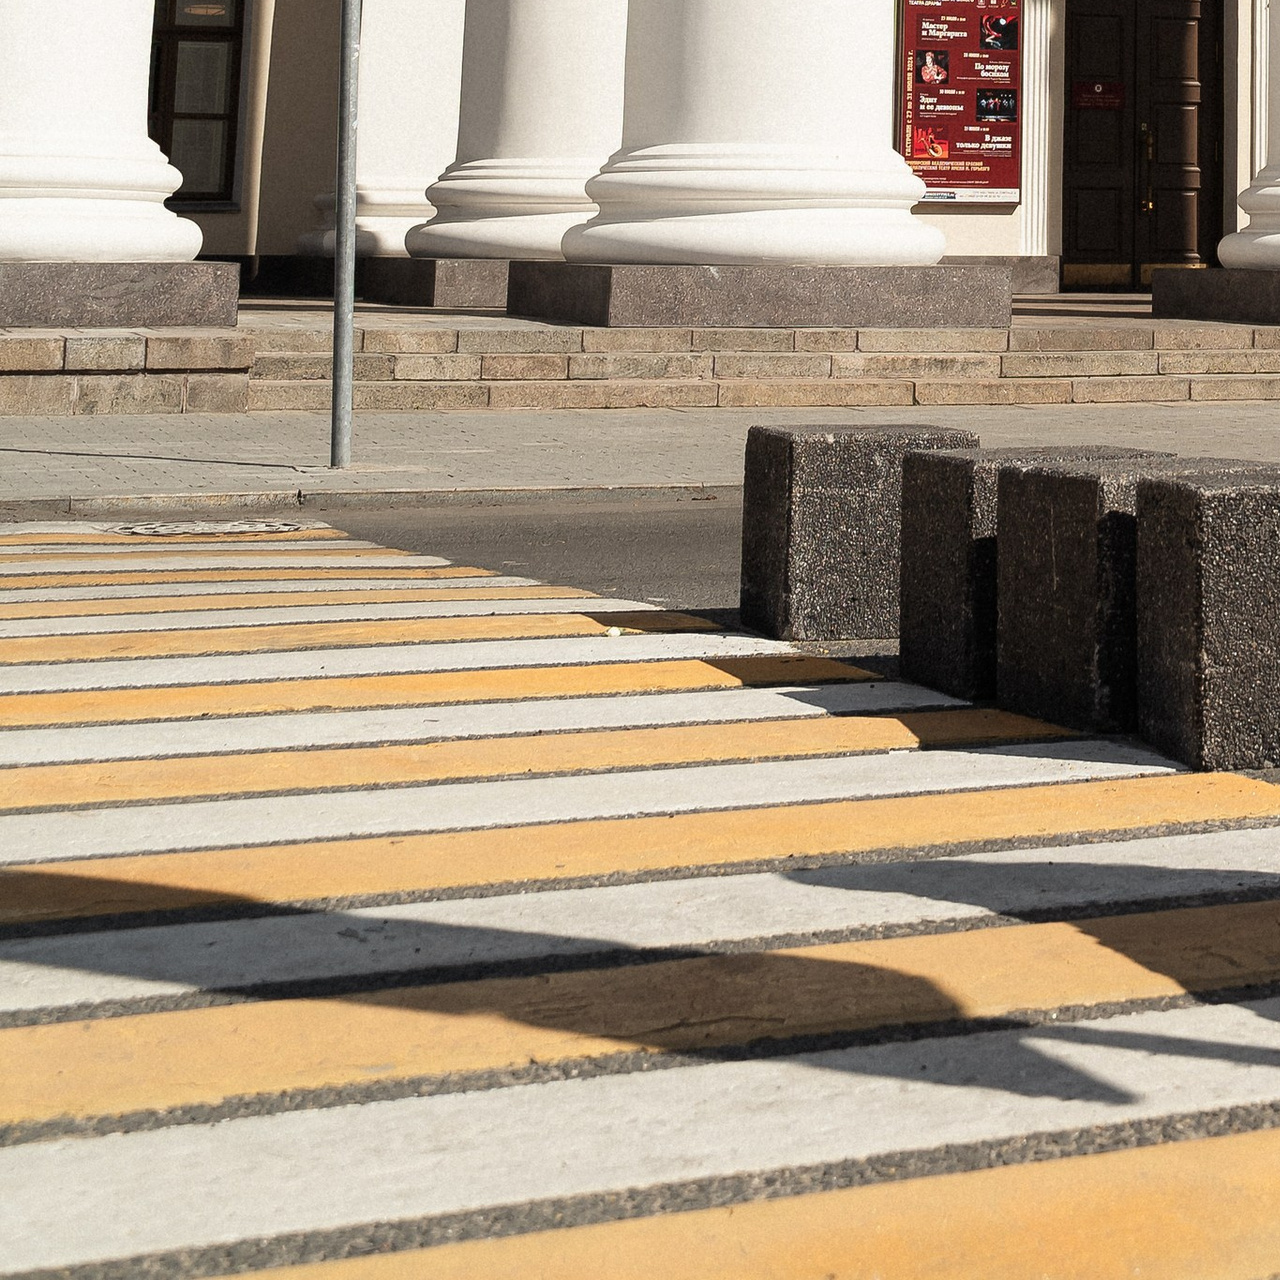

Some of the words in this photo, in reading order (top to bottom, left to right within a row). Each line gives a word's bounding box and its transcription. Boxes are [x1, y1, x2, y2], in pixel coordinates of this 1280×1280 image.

[922, 22, 948, 30] Мастер
[929, 30, 967, 39] Маргарита
[975, 62, 984, 70] По
[985, 64, 1010, 72] морозу
[907, 92, 912, 100] 31
[920, 96, 938, 104] Эдит
